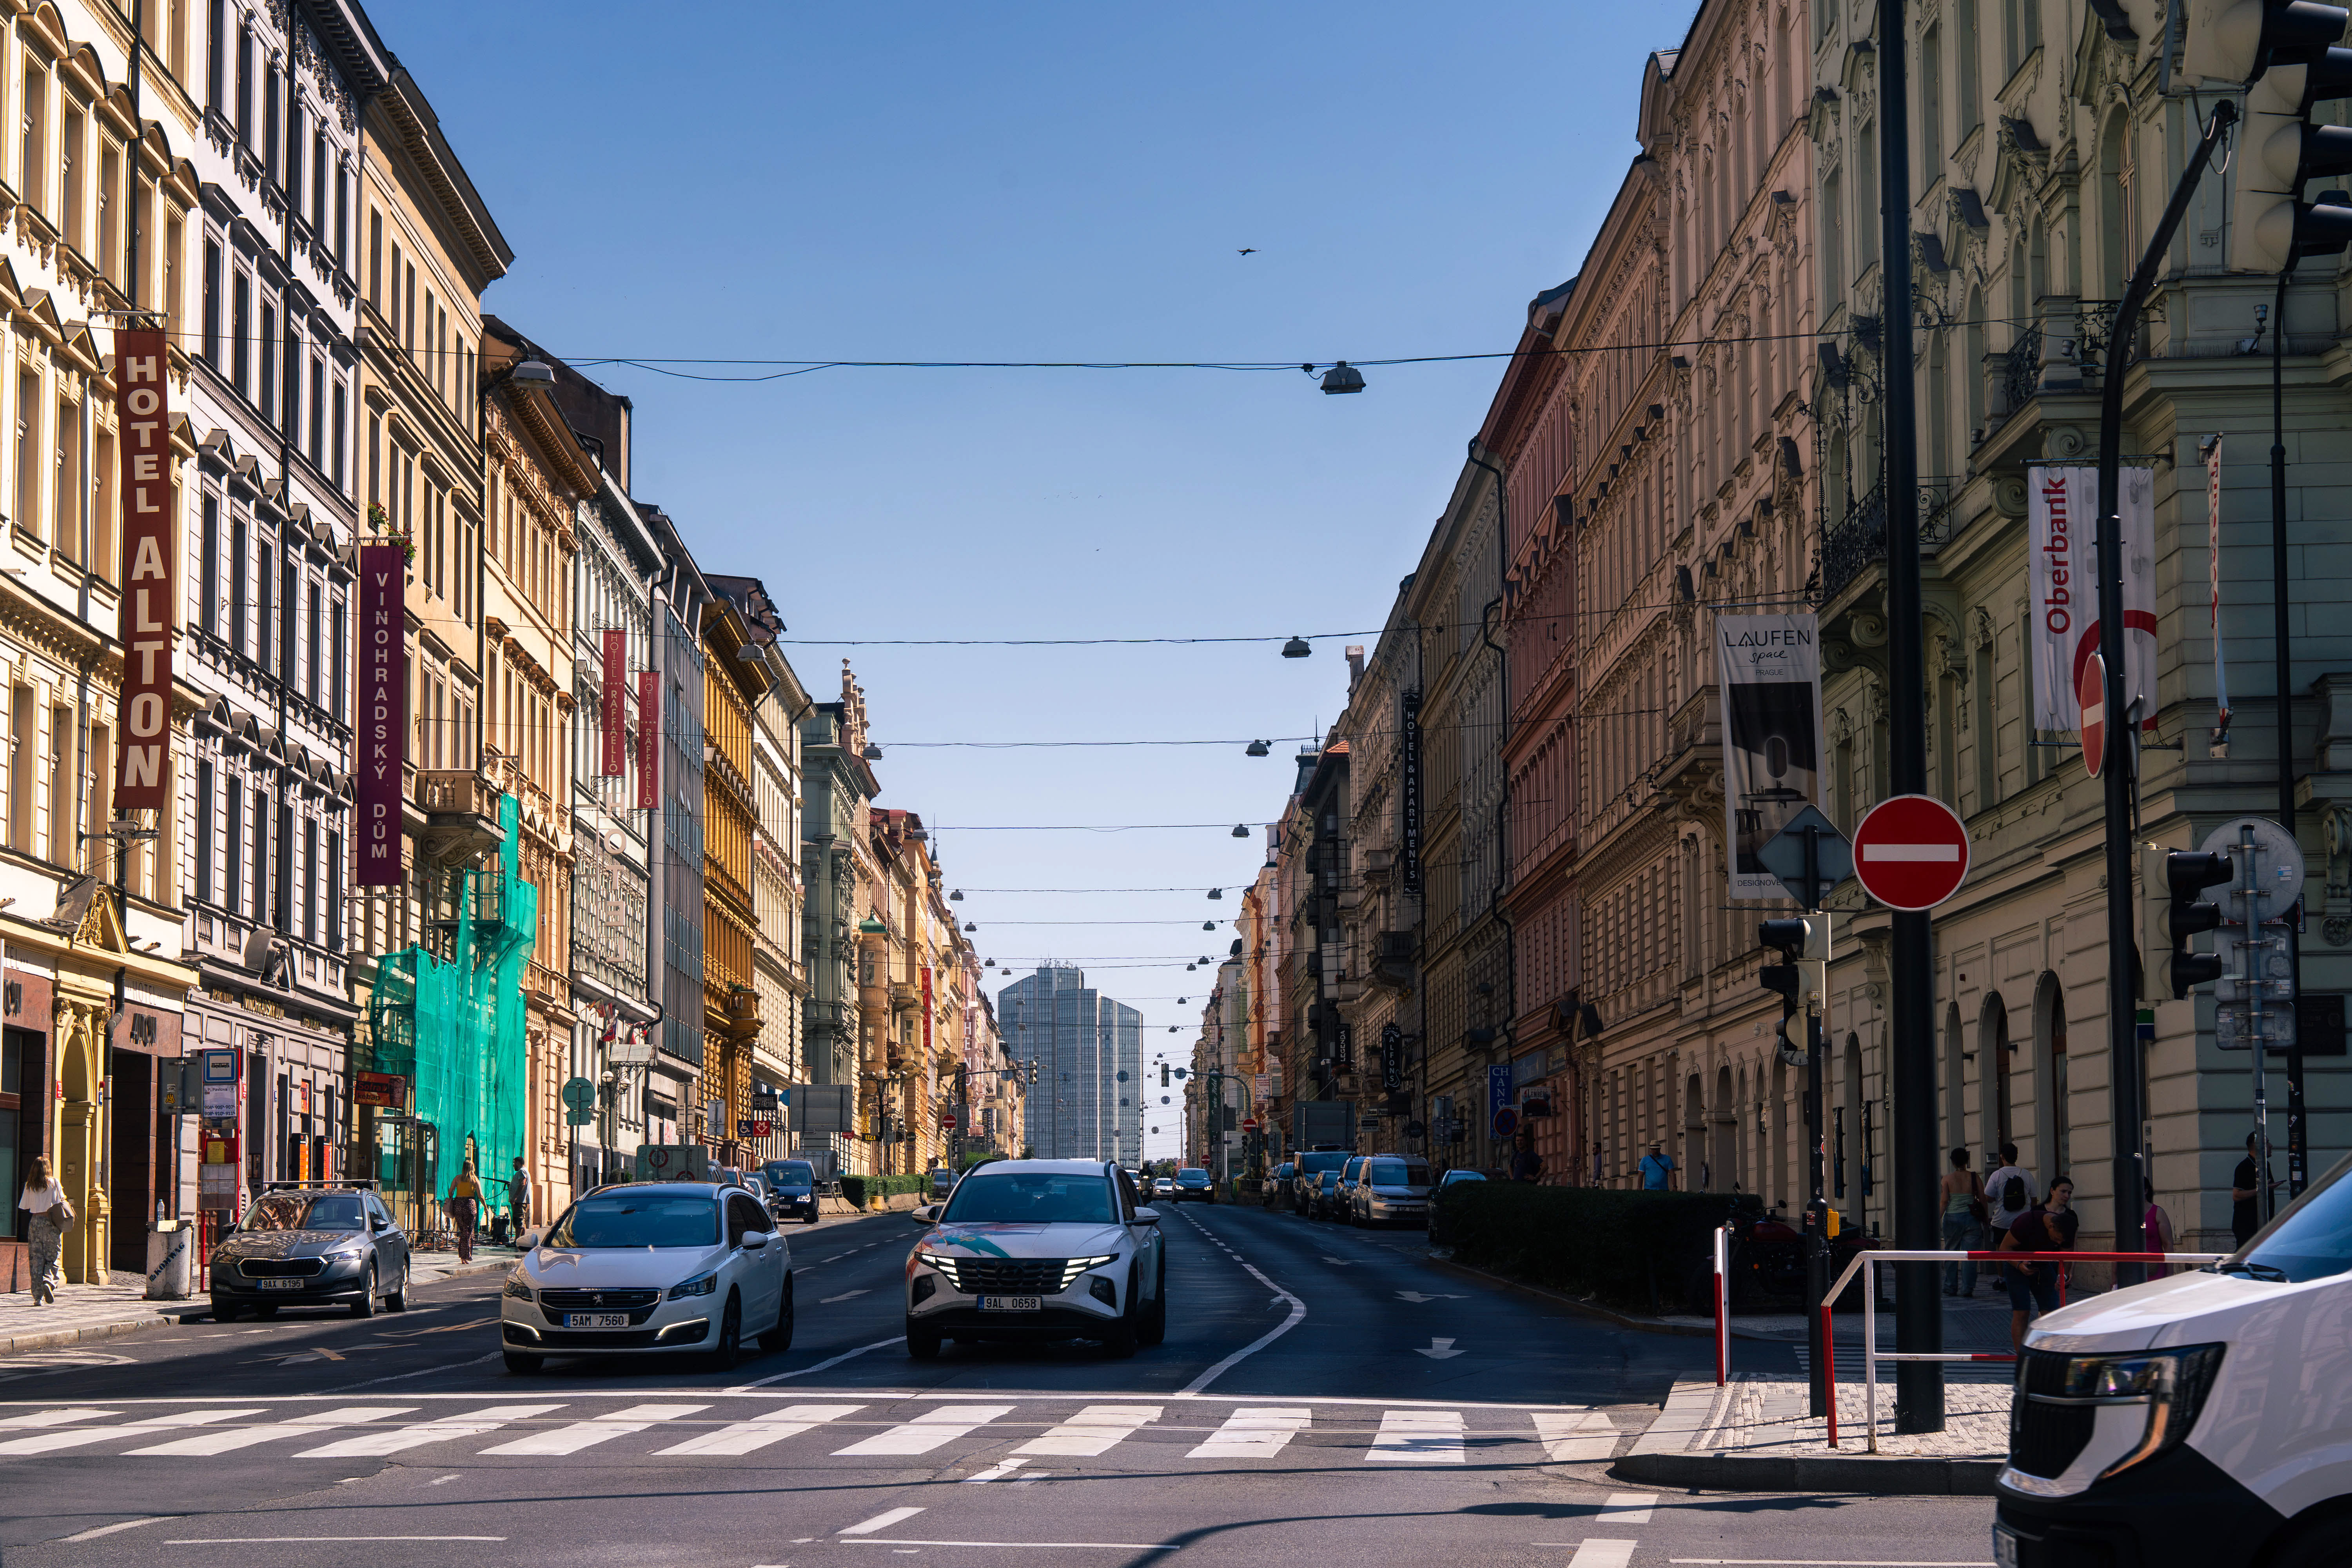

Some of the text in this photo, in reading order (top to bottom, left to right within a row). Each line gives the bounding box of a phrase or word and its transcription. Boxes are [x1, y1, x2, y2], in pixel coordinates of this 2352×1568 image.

[2042, 477, 2071, 634] Oberbank
[124, 355, 166, 787] HOTEL ALTON
[1725, 629, 1811, 648] LAUFEN
[1749, 649, 1789, 663] space
[609, 633, 619, 772] HOTEL RAFFAELLO
[372, 572, 389, 858] VINOHRADSKÝ DŮM
[644, 728, 652, 805] RAFFAELLO
[1408, 777, 1416, 878] APARTMENTS
[132, 981, 156, 1005] HOTEL
[357, 1093, 380, 1101] kebap
[358, 1082, 381, 1091] Sofra
[154, 1242, 185, 1276] KOMWAG
[263, 1280, 276, 1289] 9AX
[282, 1279, 301, 1288] 6195
[986, 1298, 1004, 1308] 9AL
[1012, 1298, 1036, 1308] 0658
[572, 1314, 591, 1327] 5AM
[599, 1314, 624, 1327] 7560
